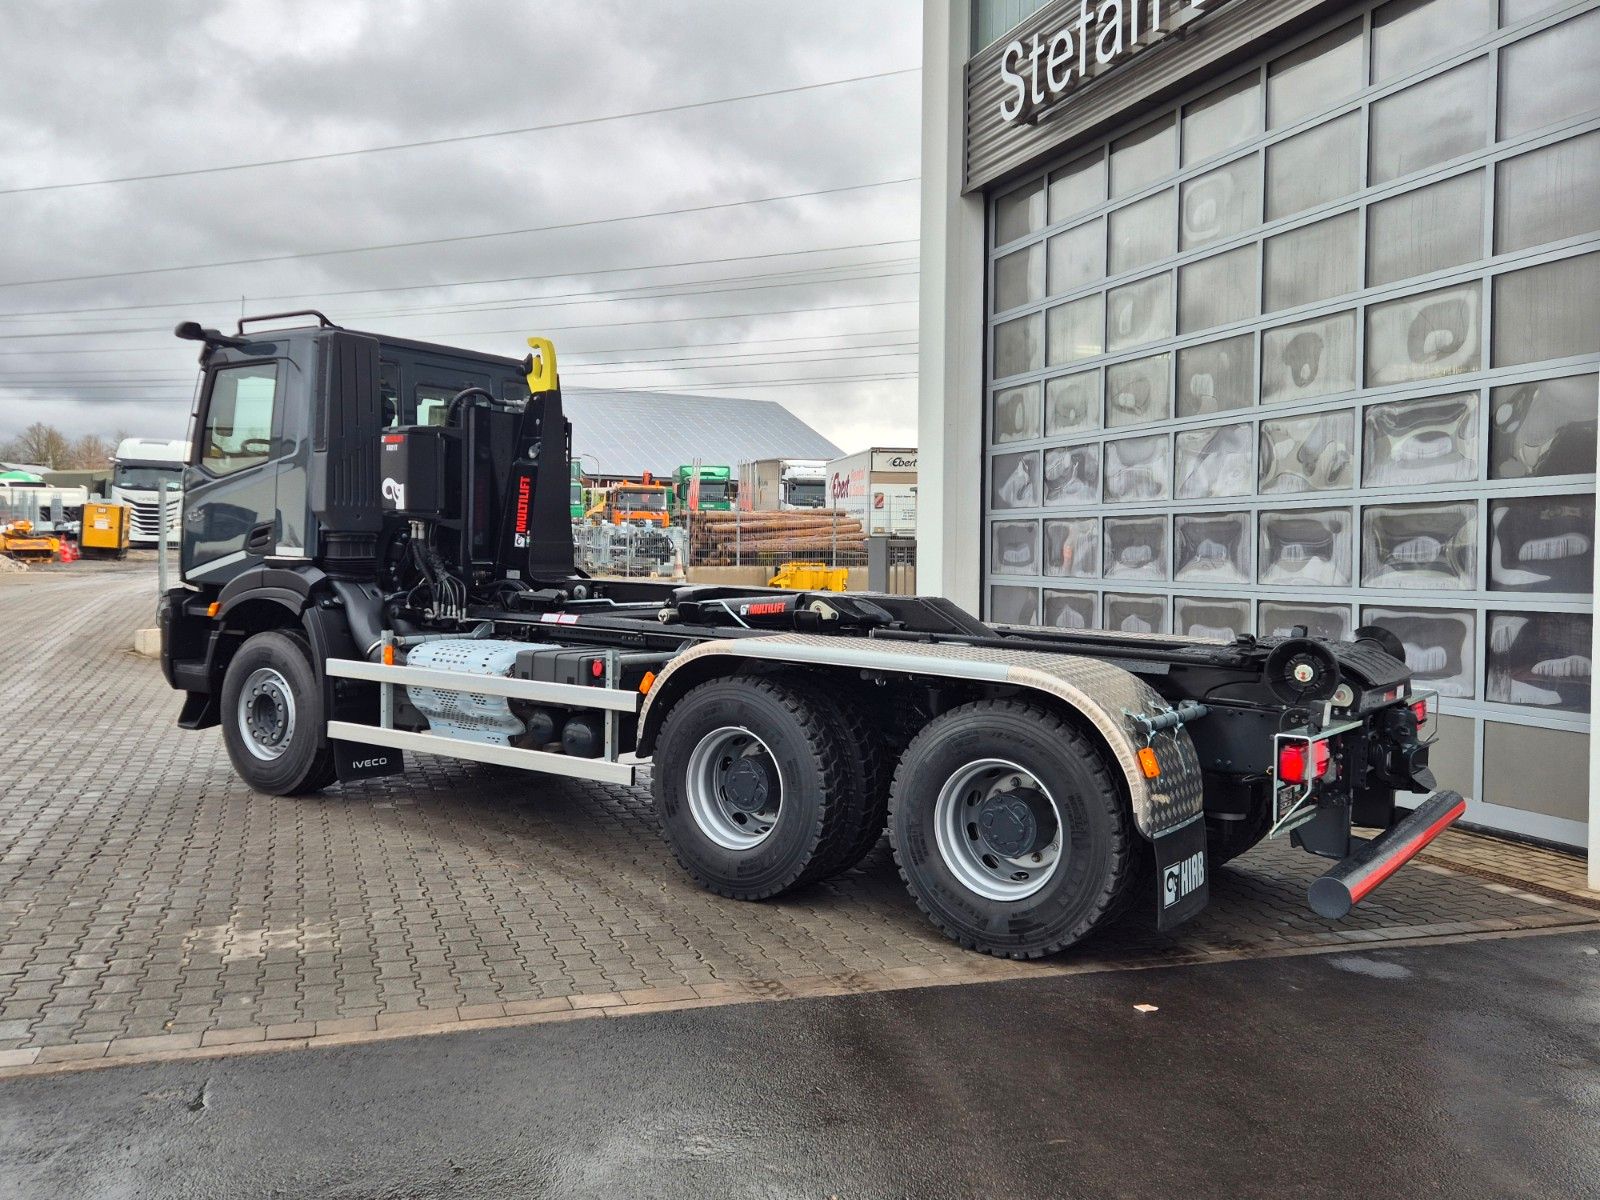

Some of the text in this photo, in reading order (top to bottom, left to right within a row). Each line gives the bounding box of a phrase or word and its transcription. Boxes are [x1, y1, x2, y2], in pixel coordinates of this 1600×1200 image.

[889, 457, 917, 467] Ebert
[516, 476, 531, 532] MULTILIFT
[750, 602, 786, 615] MULTILIFT
[352, 757, 387, 769] IVECO
[1181, 850, 1205, 897] HIAB
